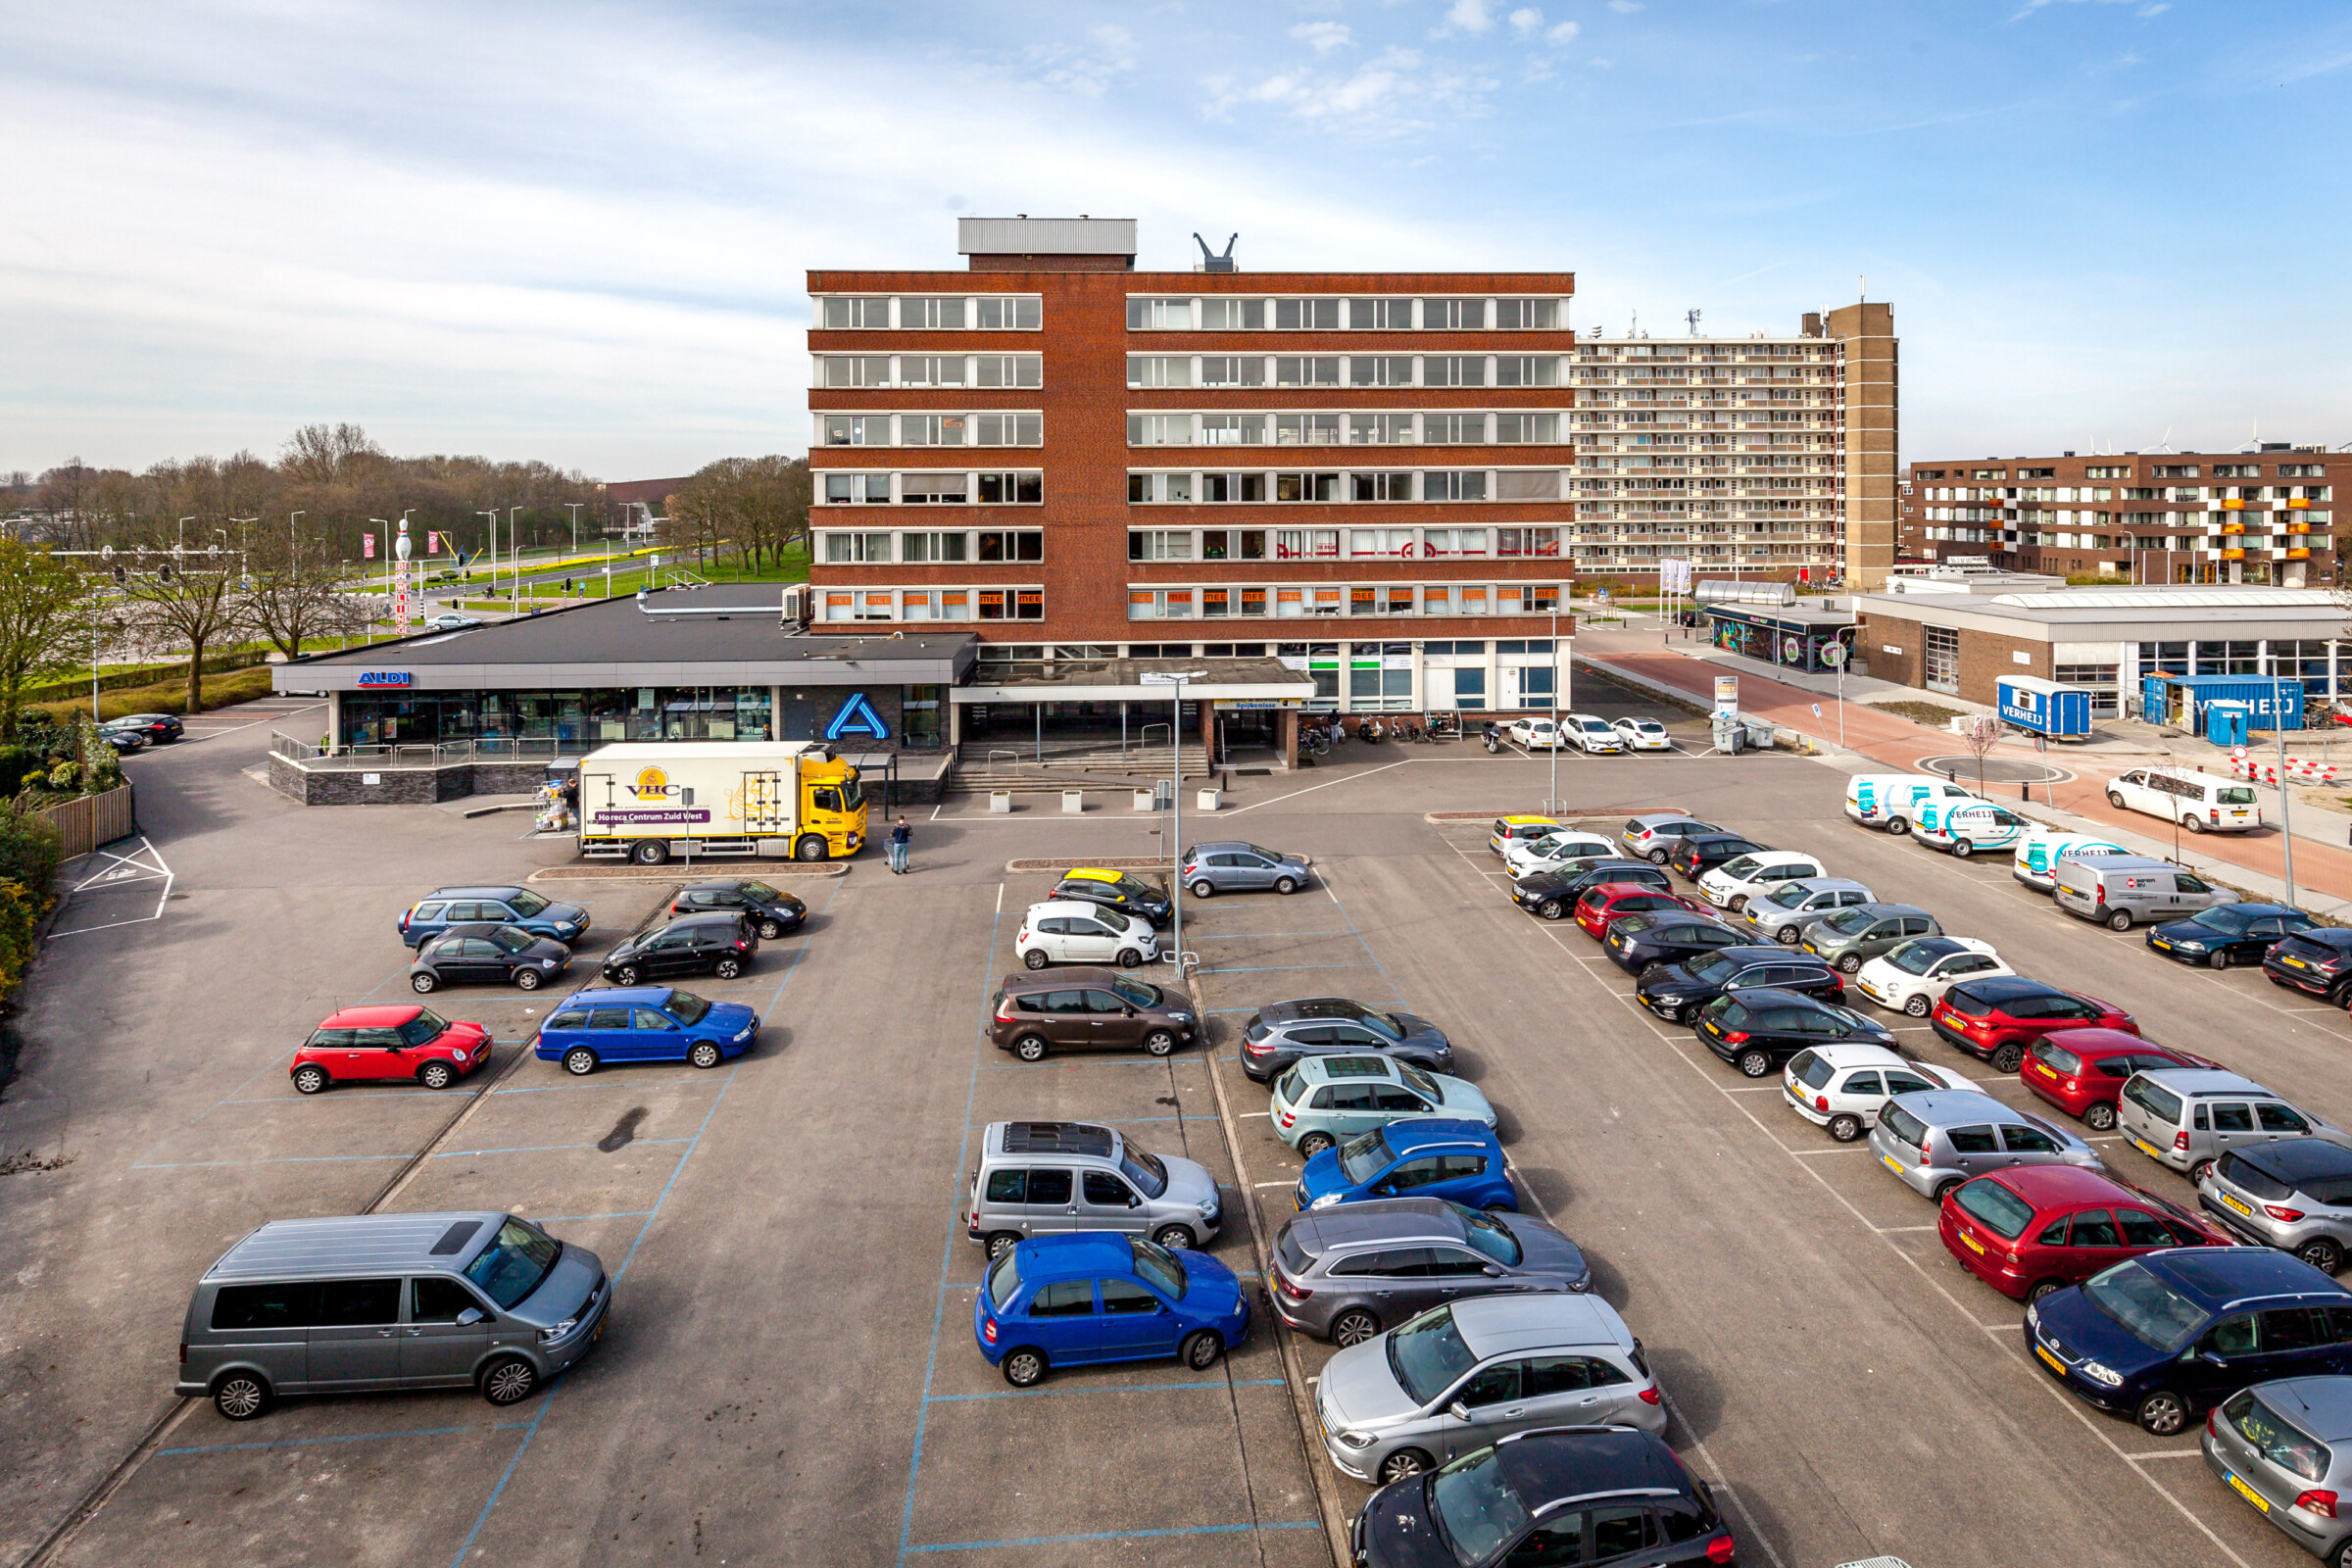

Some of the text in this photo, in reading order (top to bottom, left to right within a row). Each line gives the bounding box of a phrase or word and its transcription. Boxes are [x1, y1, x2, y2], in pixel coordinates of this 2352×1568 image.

[358, 672, 410, 684] ALDI
[2002, 704, 2043, 725] VERHEIJ
[625, 784, 681, 797] VHC
